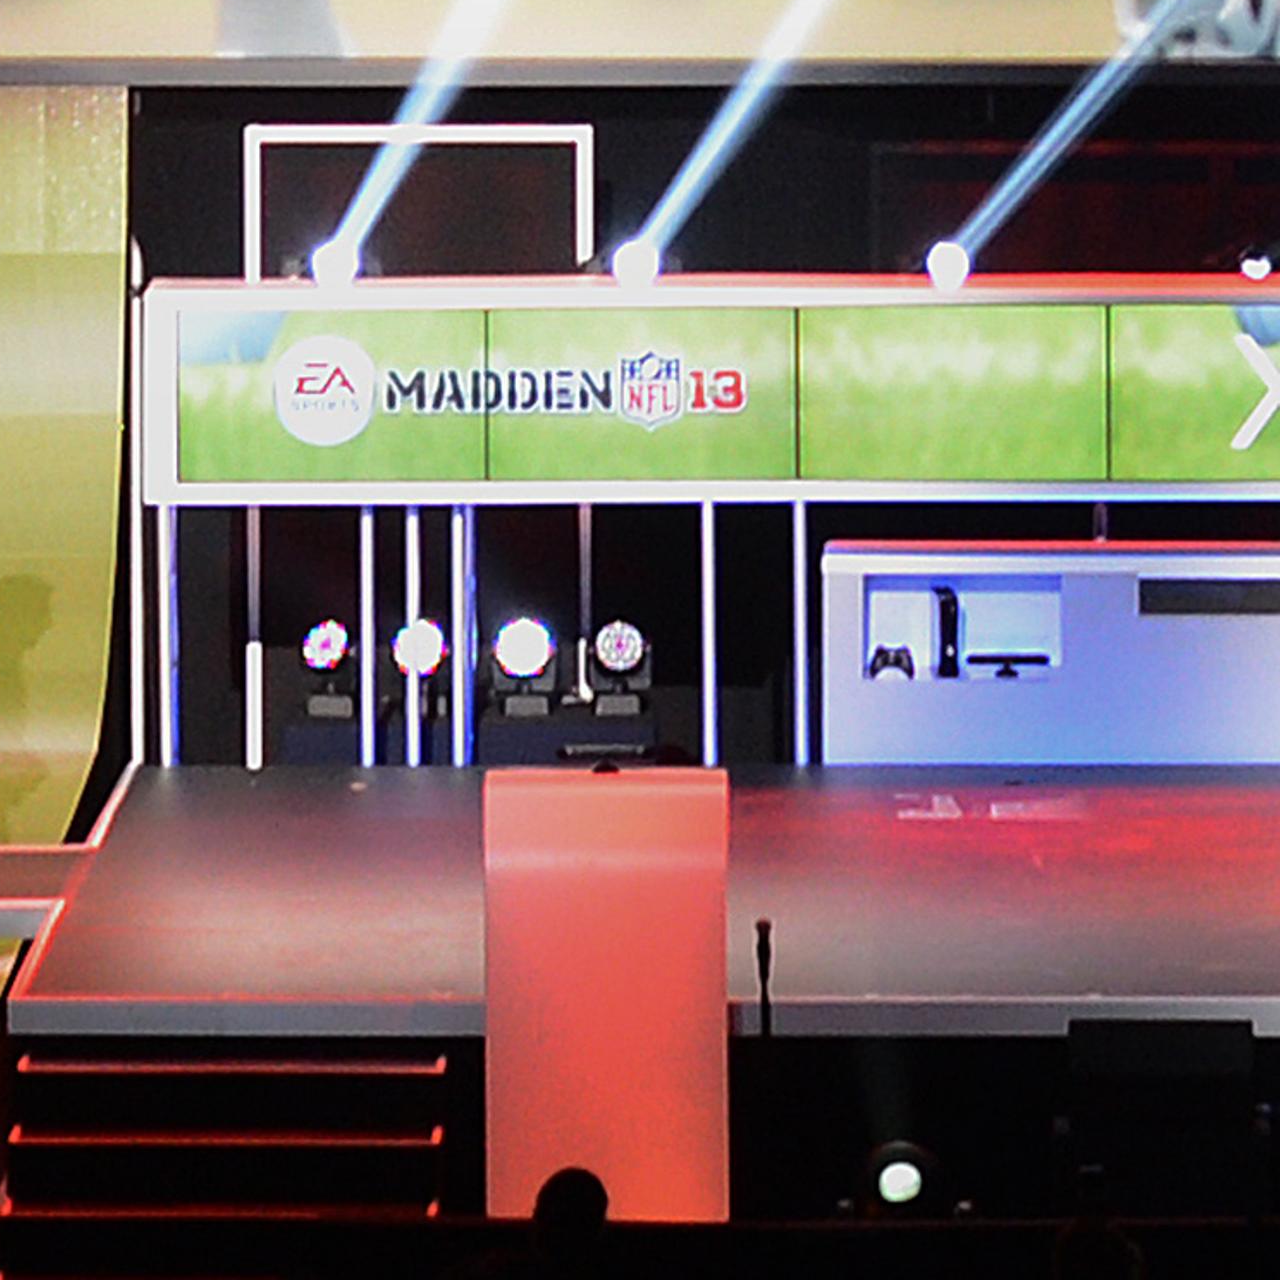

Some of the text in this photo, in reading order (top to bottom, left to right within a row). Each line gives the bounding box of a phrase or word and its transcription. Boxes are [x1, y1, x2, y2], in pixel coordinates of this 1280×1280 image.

[293, 362, 356, 395] EA
[385, 368, 745, 415] MADDEN NFL 13
